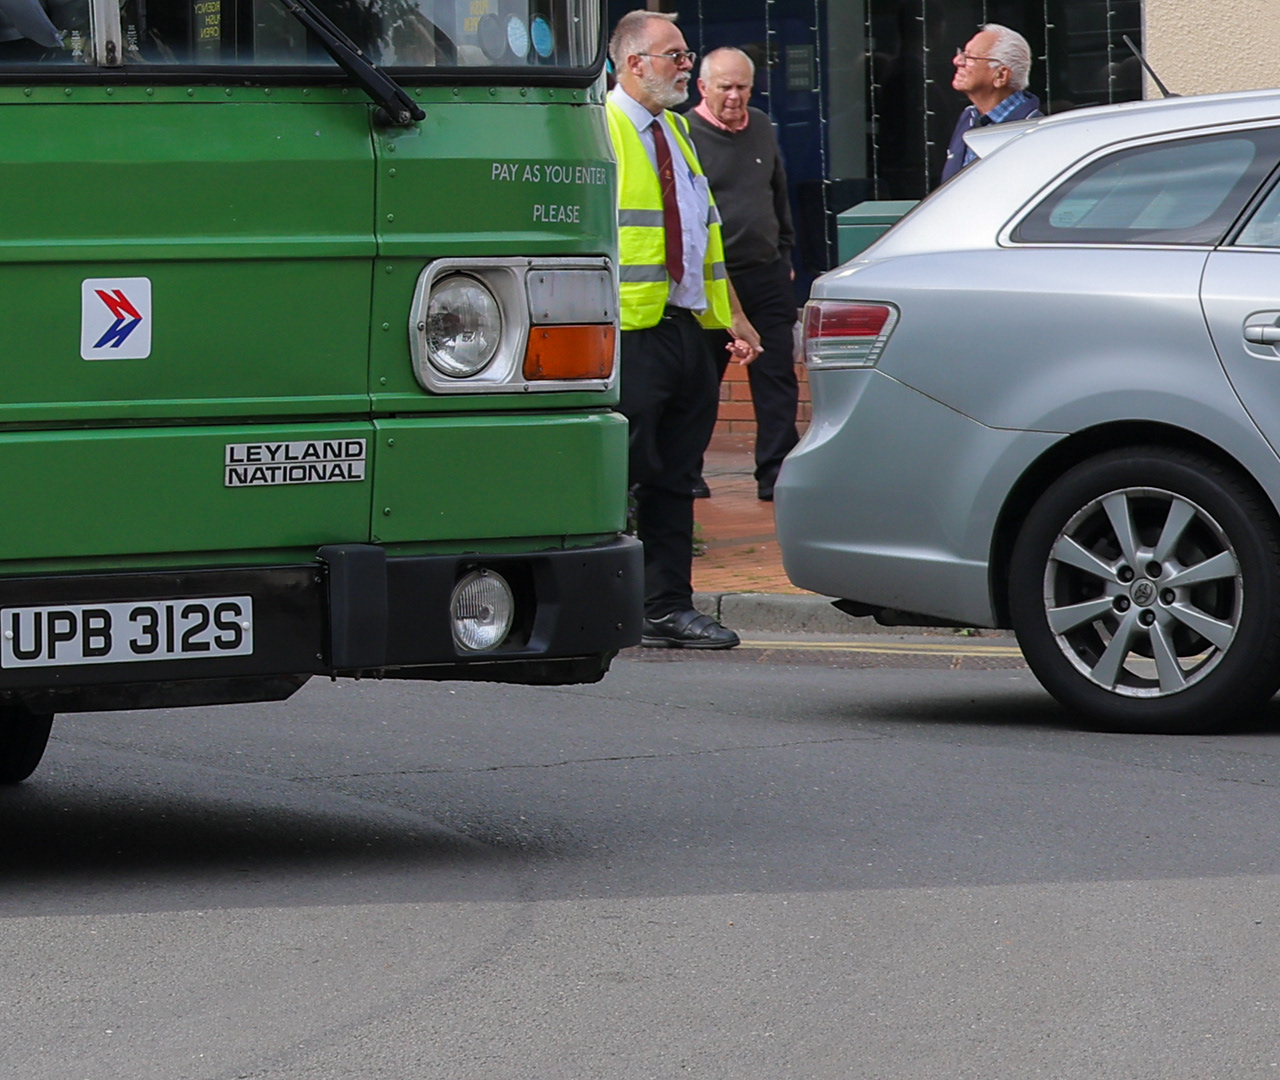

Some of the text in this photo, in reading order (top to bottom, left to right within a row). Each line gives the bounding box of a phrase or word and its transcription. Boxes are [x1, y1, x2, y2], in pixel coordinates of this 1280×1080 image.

[492, 163, 607, 185] PAY AS YOU ENTER
[533, 205, 580, 223] PLEASE
[230, 441, 363, 463] LEYLAND
[228, 463, 362, 484] NATIONAL
[12, 602, 243, 660] UPB 312S
